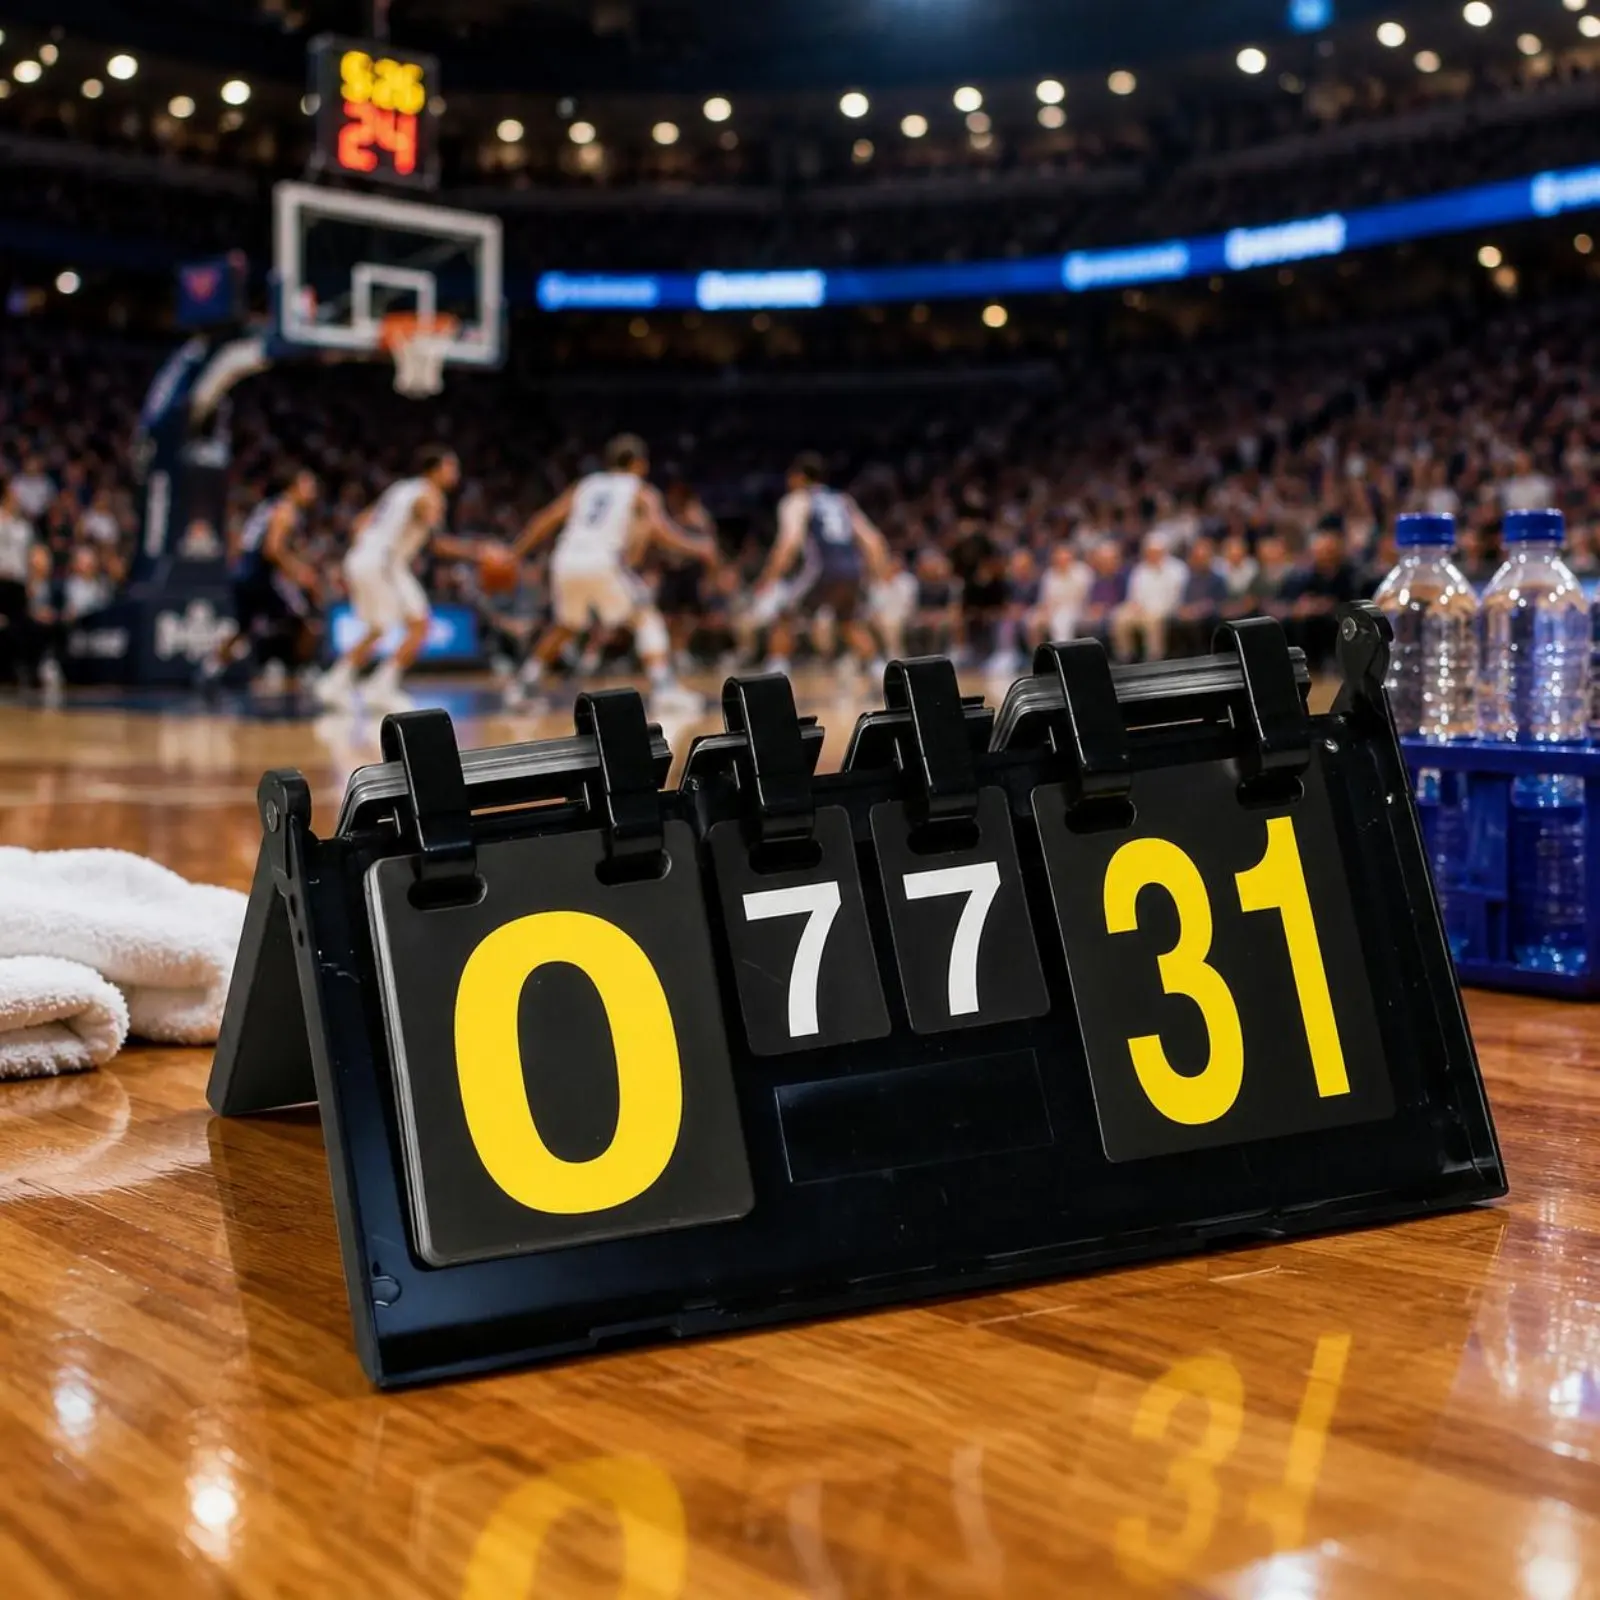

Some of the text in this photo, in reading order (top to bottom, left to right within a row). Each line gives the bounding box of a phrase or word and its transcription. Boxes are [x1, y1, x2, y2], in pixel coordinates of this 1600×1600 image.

[338, 101, 417, 175] 24
[453, 815, 1352, 1215] 0 7 7 31
